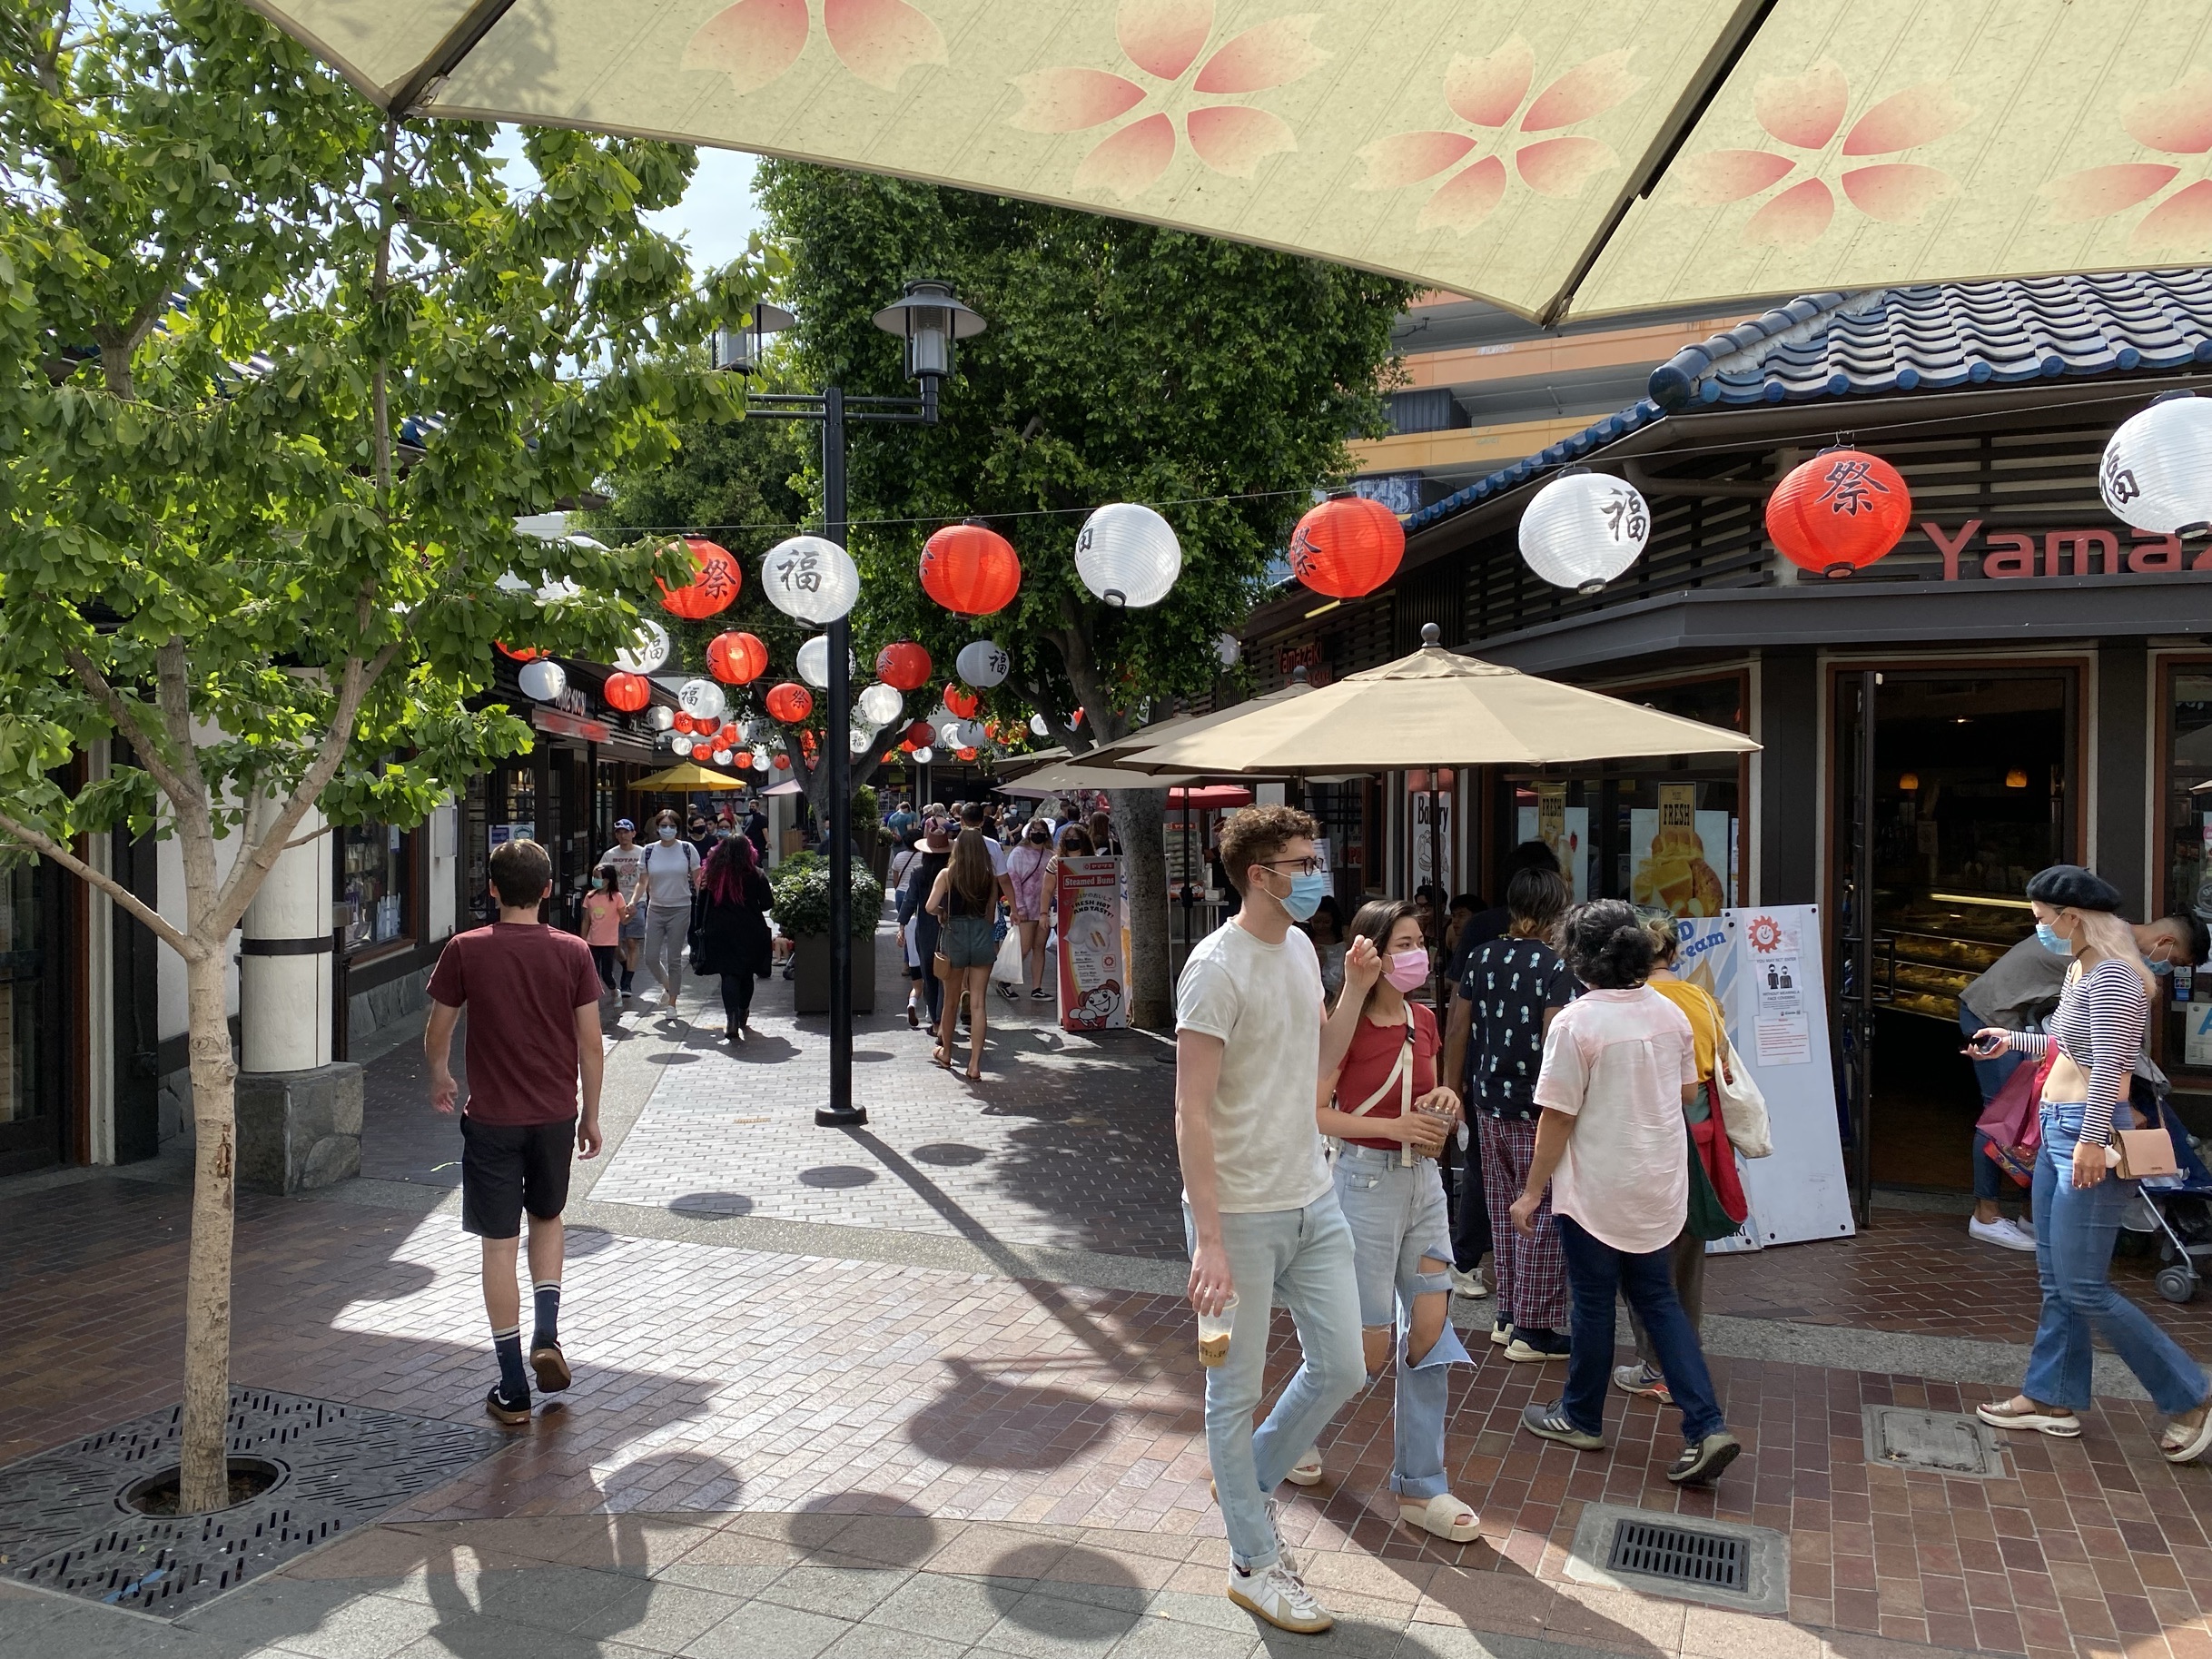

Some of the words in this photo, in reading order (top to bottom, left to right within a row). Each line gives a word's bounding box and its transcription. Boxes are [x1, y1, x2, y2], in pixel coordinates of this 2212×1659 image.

[1815, 460, 1891, 517] 祭
[1600, 488, 1646, 542] 福
[695, 558, 736, 600] 祭
[777, 548, 823, 593] 福
[989, 649, 1007, 676] 福
[681, 686, 699, 706] 福
[790, 690, 809, 709] 祭
[1417, 795, 1449, 833] Bary
[1542, 798, 1562, 817] FRESH
[1664, 804, 1690, 826] FRESH
[1064, 876, 1095, 886] Steamed
[1096, 875, 1114, 885] Buns
[1071, 900, 1095, 909] FRESH
[1096, 901, 1111, 909] HOT
[1073, 906, 1090, 914] AND
[1090, 906, 1115, 919] TASTY!
